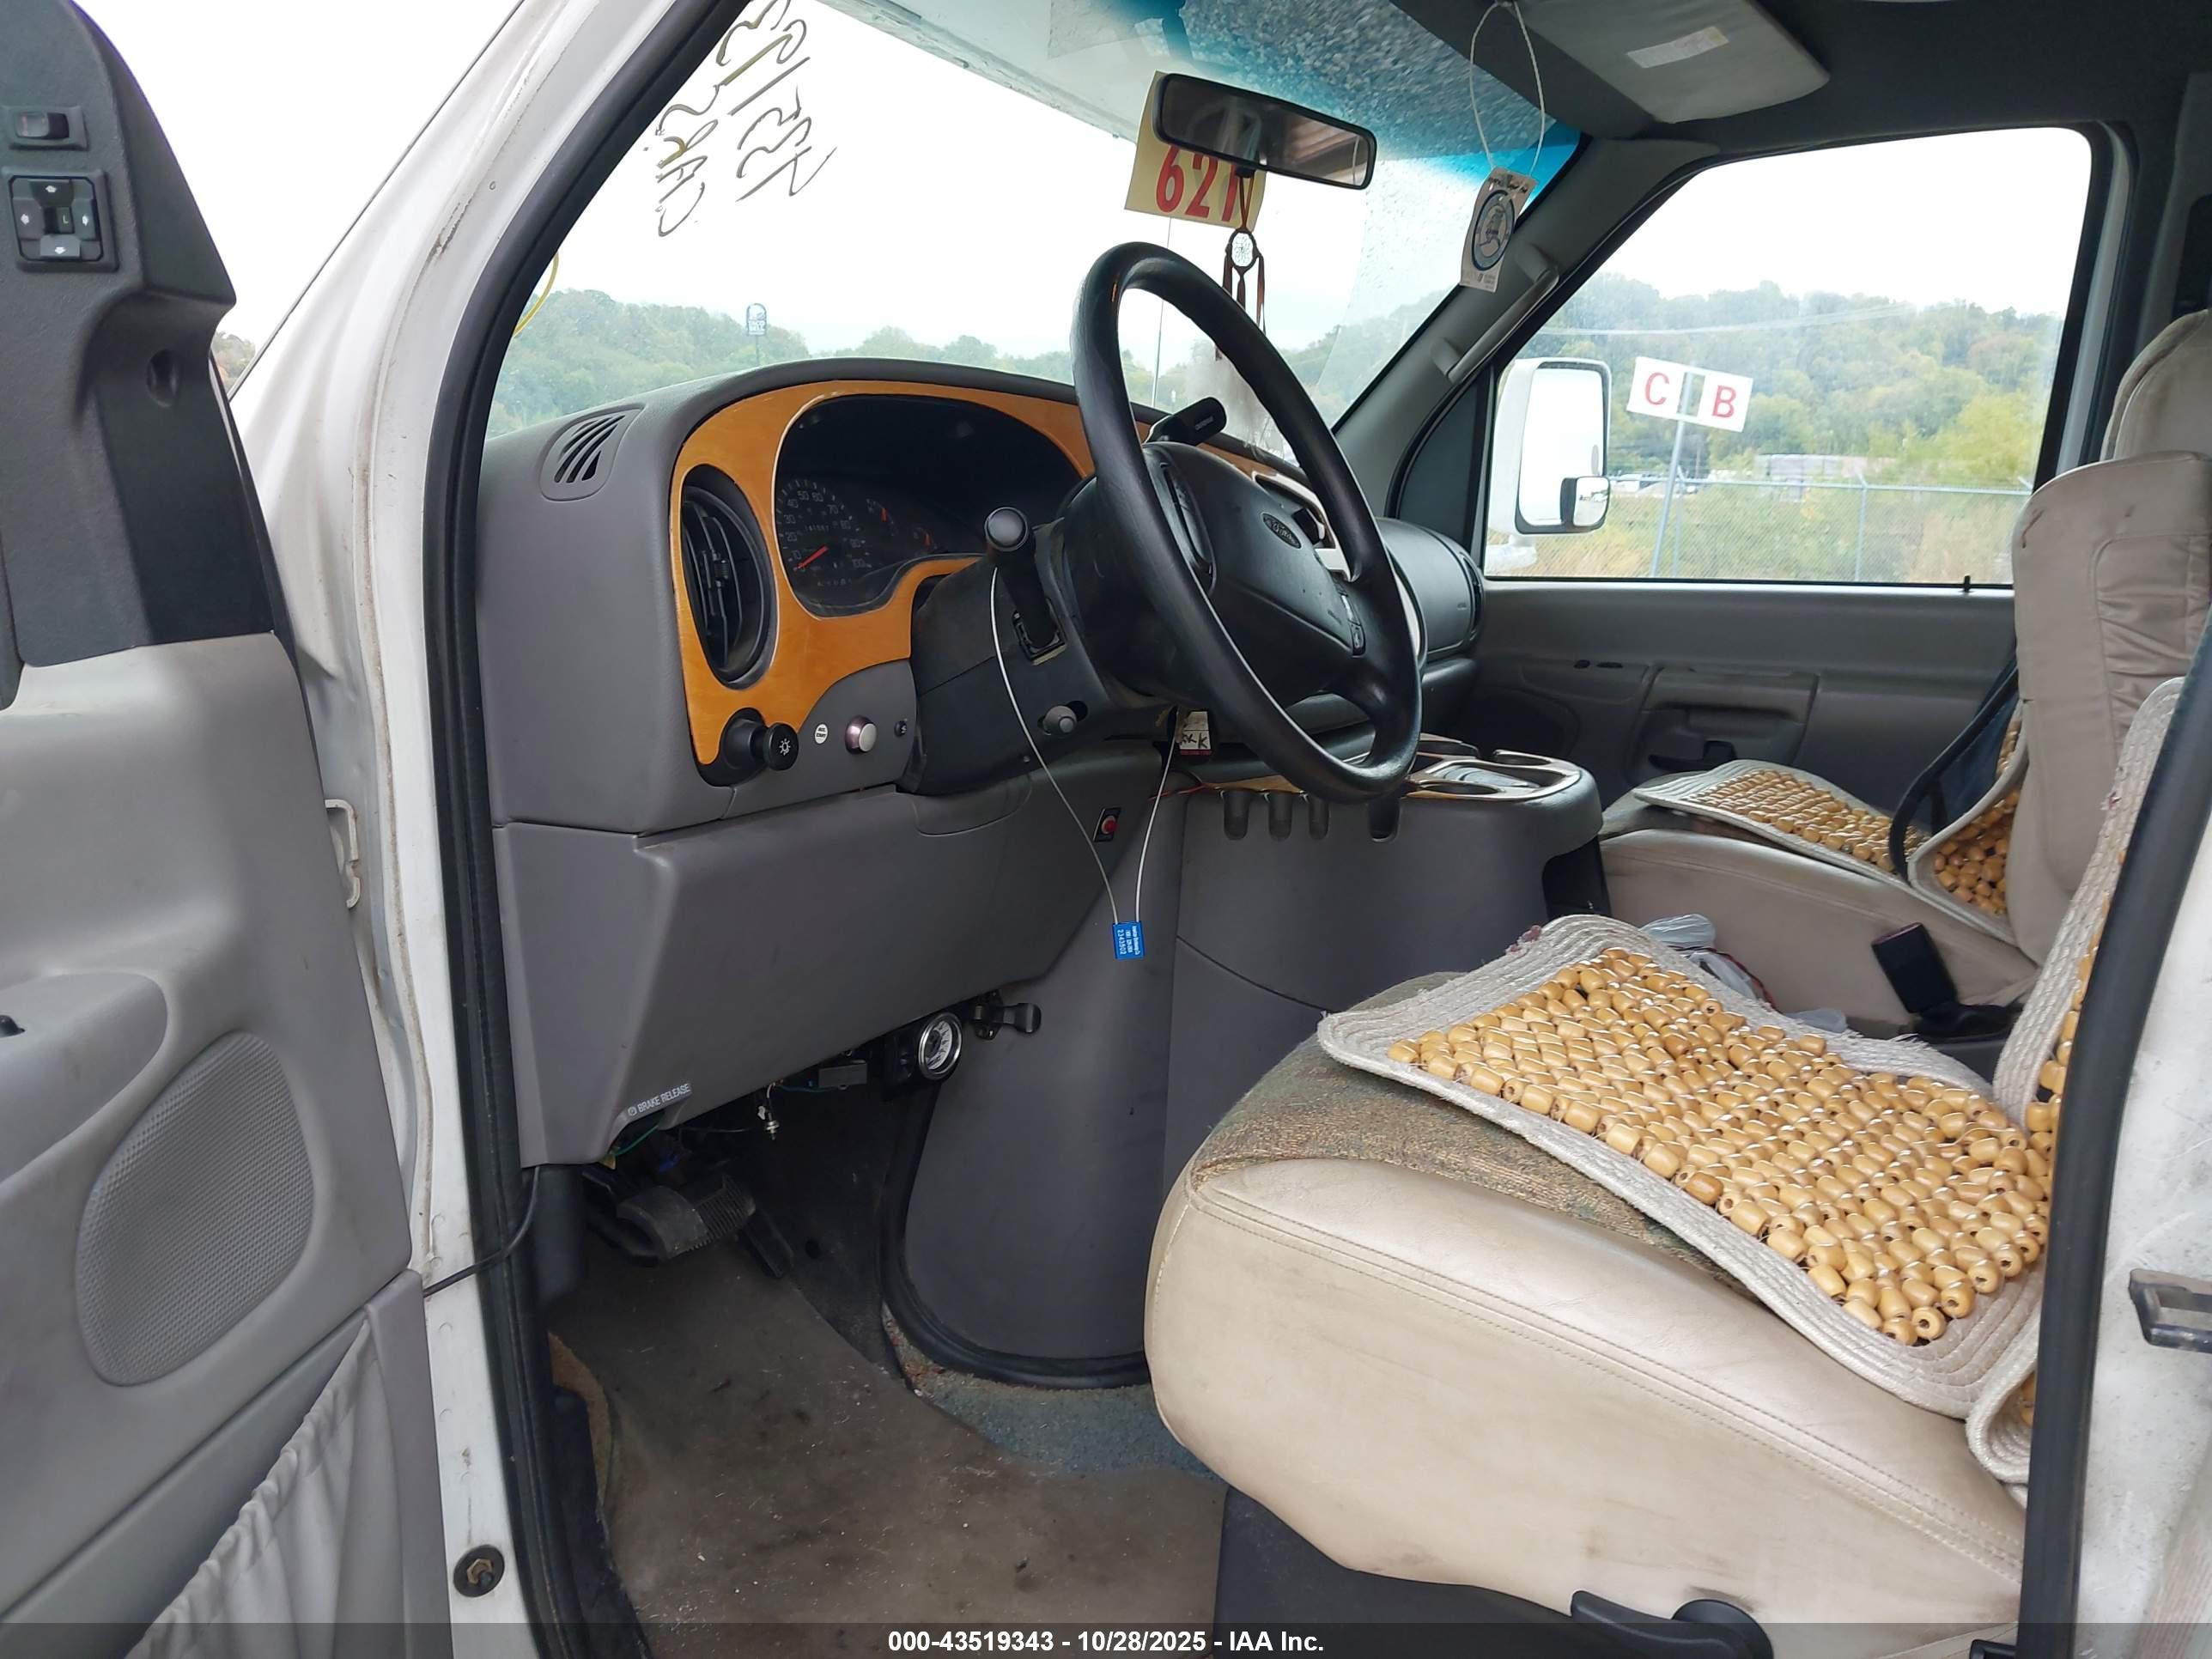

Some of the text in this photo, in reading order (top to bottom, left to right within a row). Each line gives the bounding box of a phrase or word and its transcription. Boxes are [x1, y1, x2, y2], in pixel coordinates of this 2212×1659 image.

[1644, 372, 1737, 418] C B
[637, 1084, 690, 1112] BRAKE RELEASE
